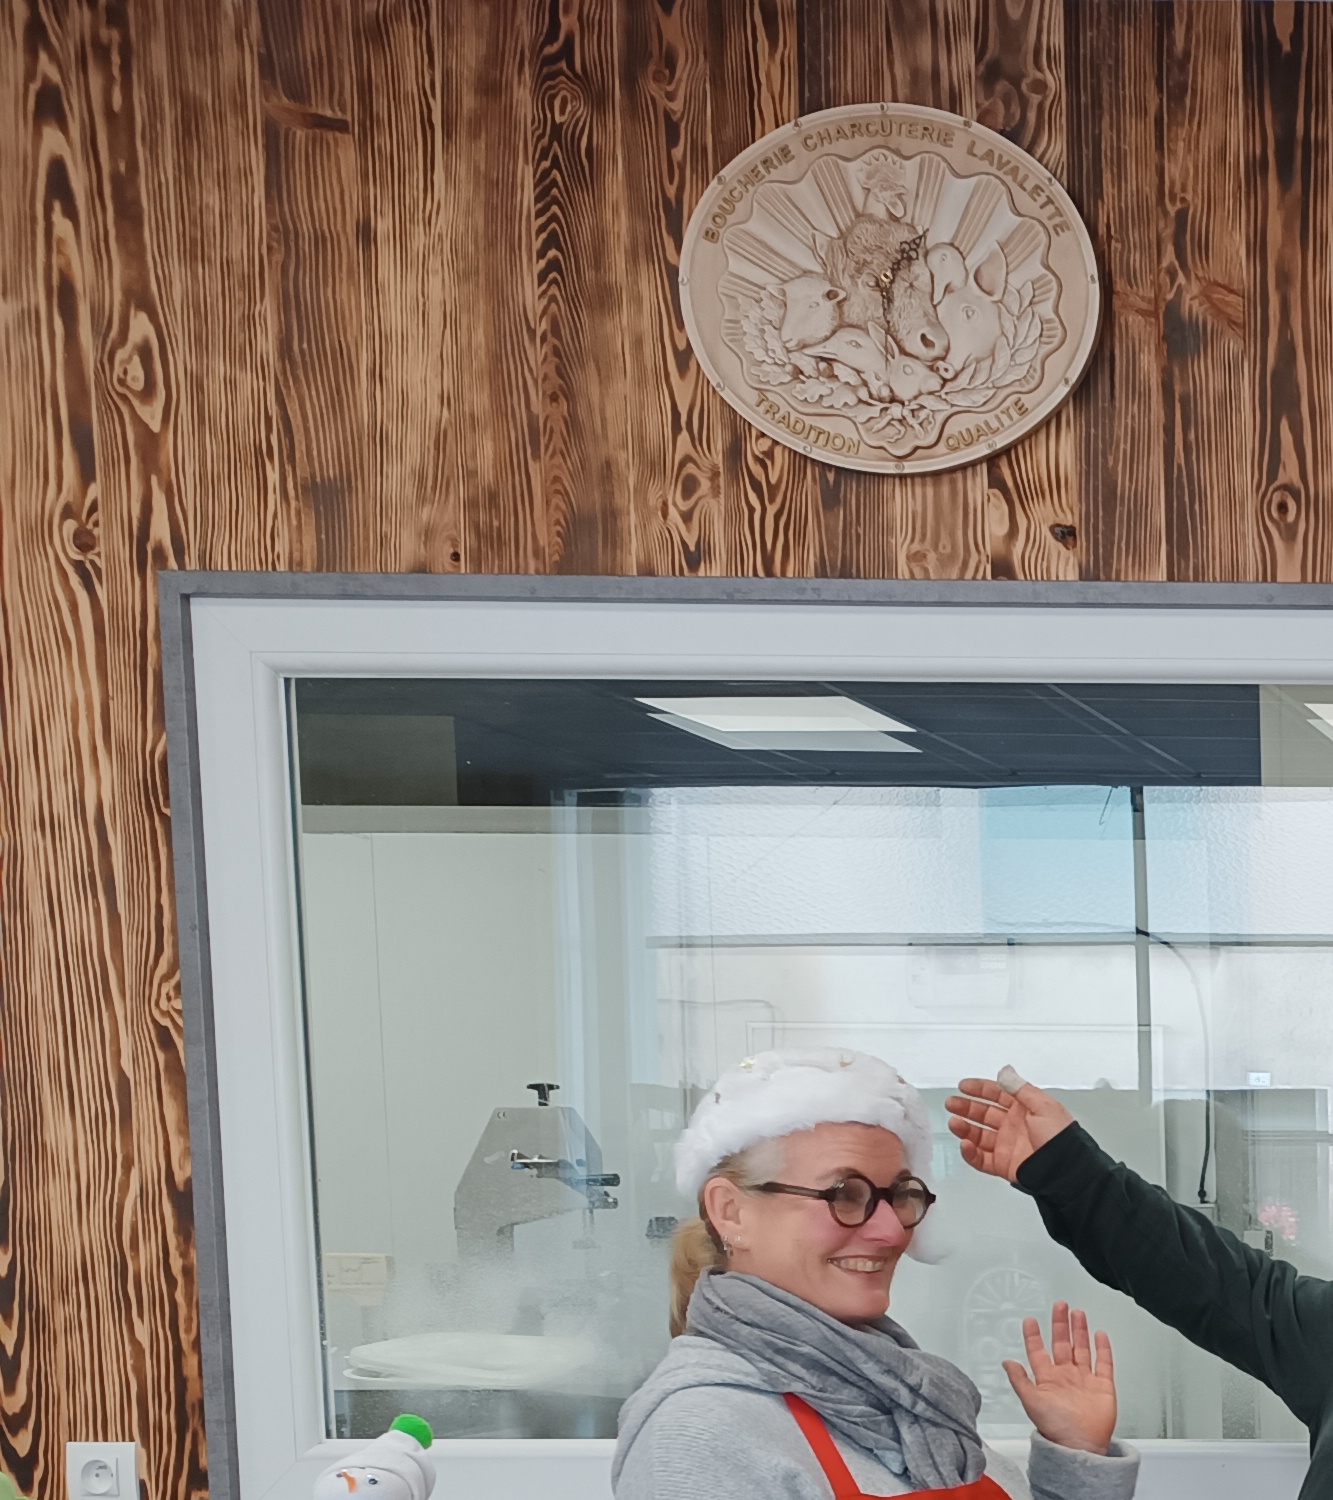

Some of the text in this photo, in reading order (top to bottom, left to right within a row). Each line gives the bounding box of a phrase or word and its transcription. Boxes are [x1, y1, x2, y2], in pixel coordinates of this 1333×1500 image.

[702, 118, 1072, 244] BOUCHERIE CHARCUTERIE LAVALETTE
[754, 391, 1030, 455] TRADITION QUALITE
